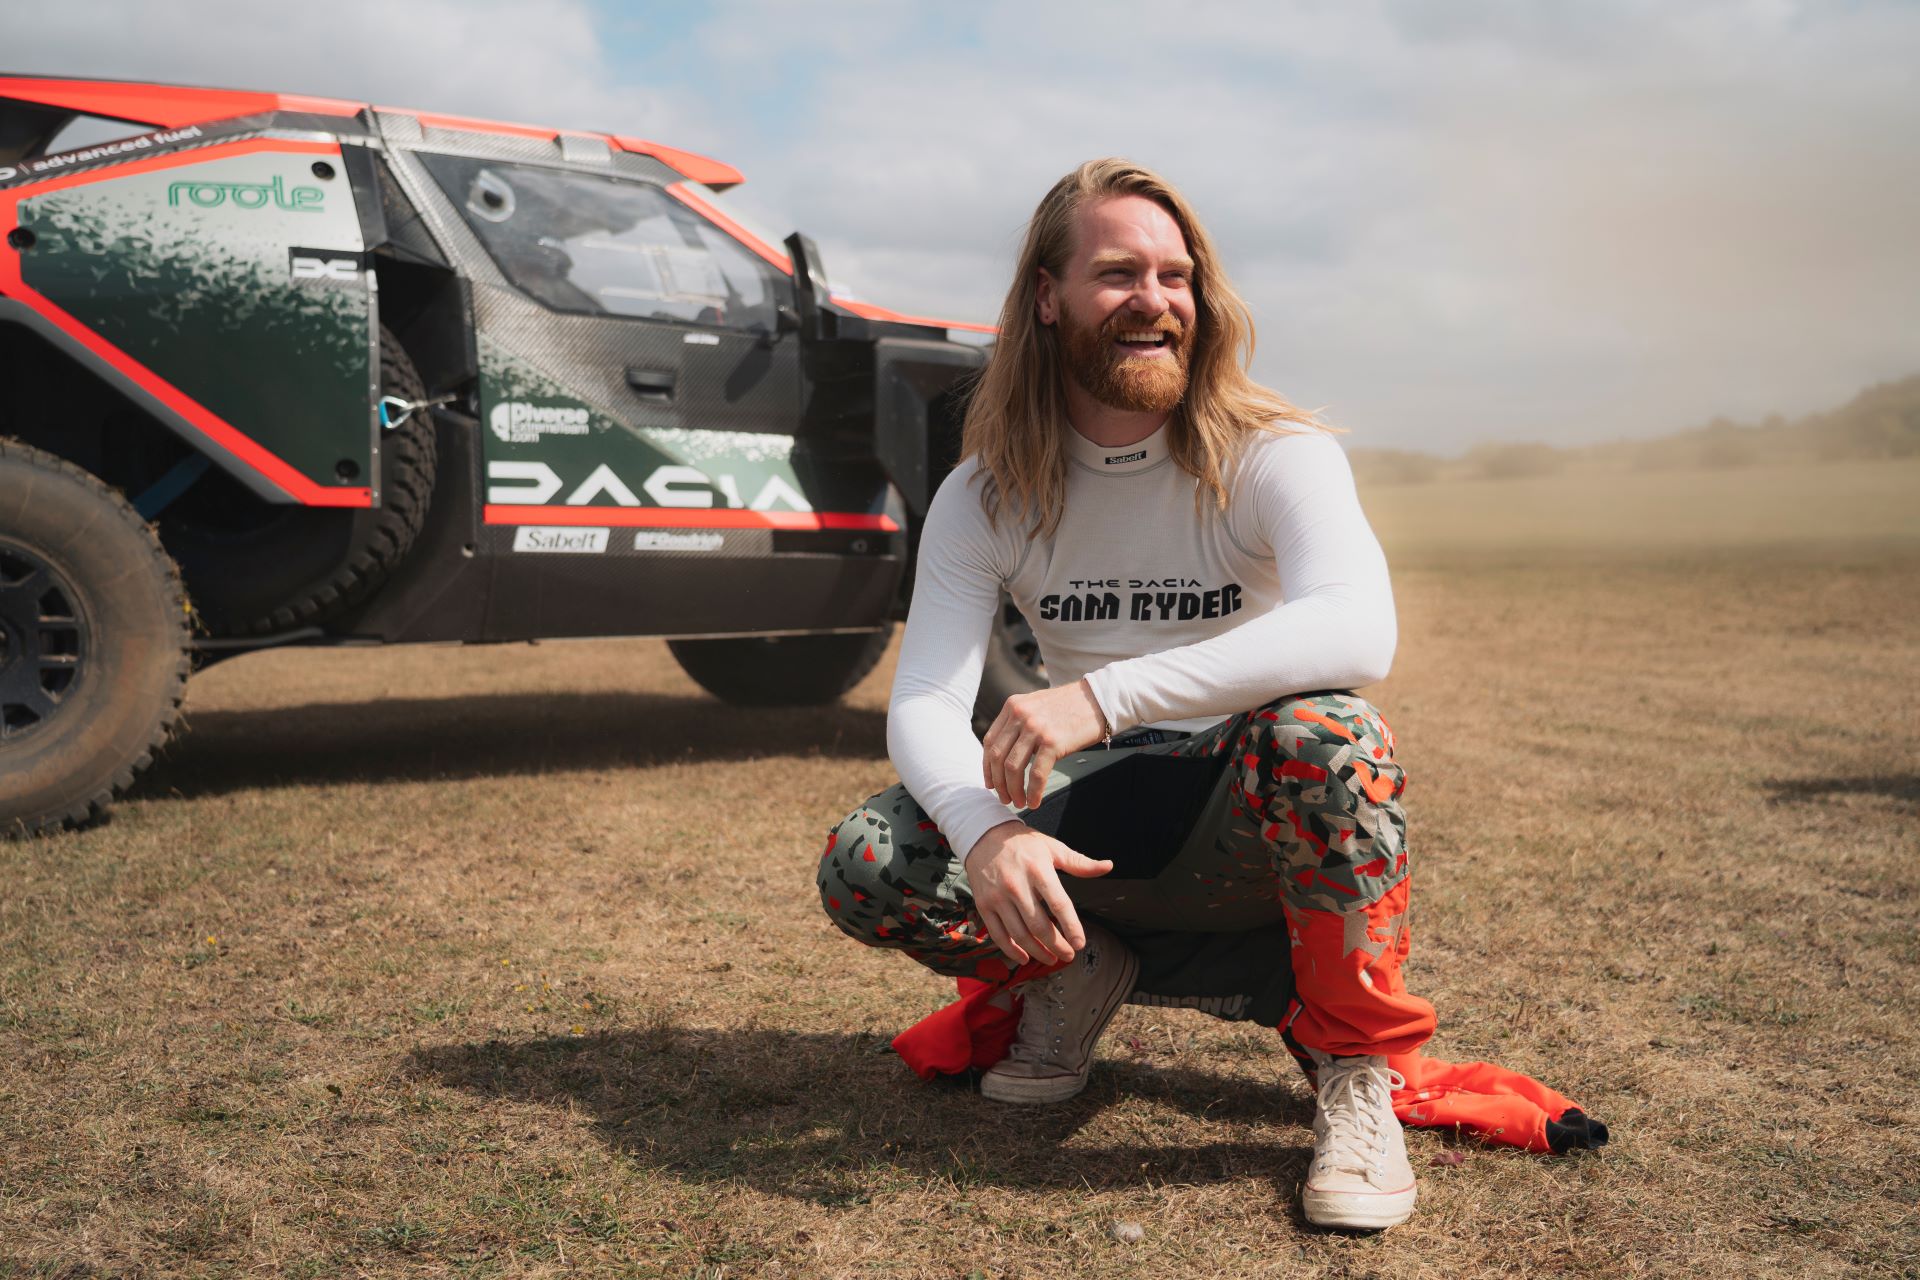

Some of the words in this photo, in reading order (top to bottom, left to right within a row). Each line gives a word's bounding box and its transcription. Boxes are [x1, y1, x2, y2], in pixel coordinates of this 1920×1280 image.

[32, 136, 152, 172] advanced
[153, 125, 203, 145] fuel
[1109, 452, 1144, 464] Sabelt
[488, 461, 813, 512] DACIA
[526, 529, 597, 550] Sabelt
[1069, 580, 1121, 589] THE
[1128, 578, 1203, 588] DACIA
[1039, 592, 1120, 622] SAM
[1129, 583, 1242, 621] RYDER
